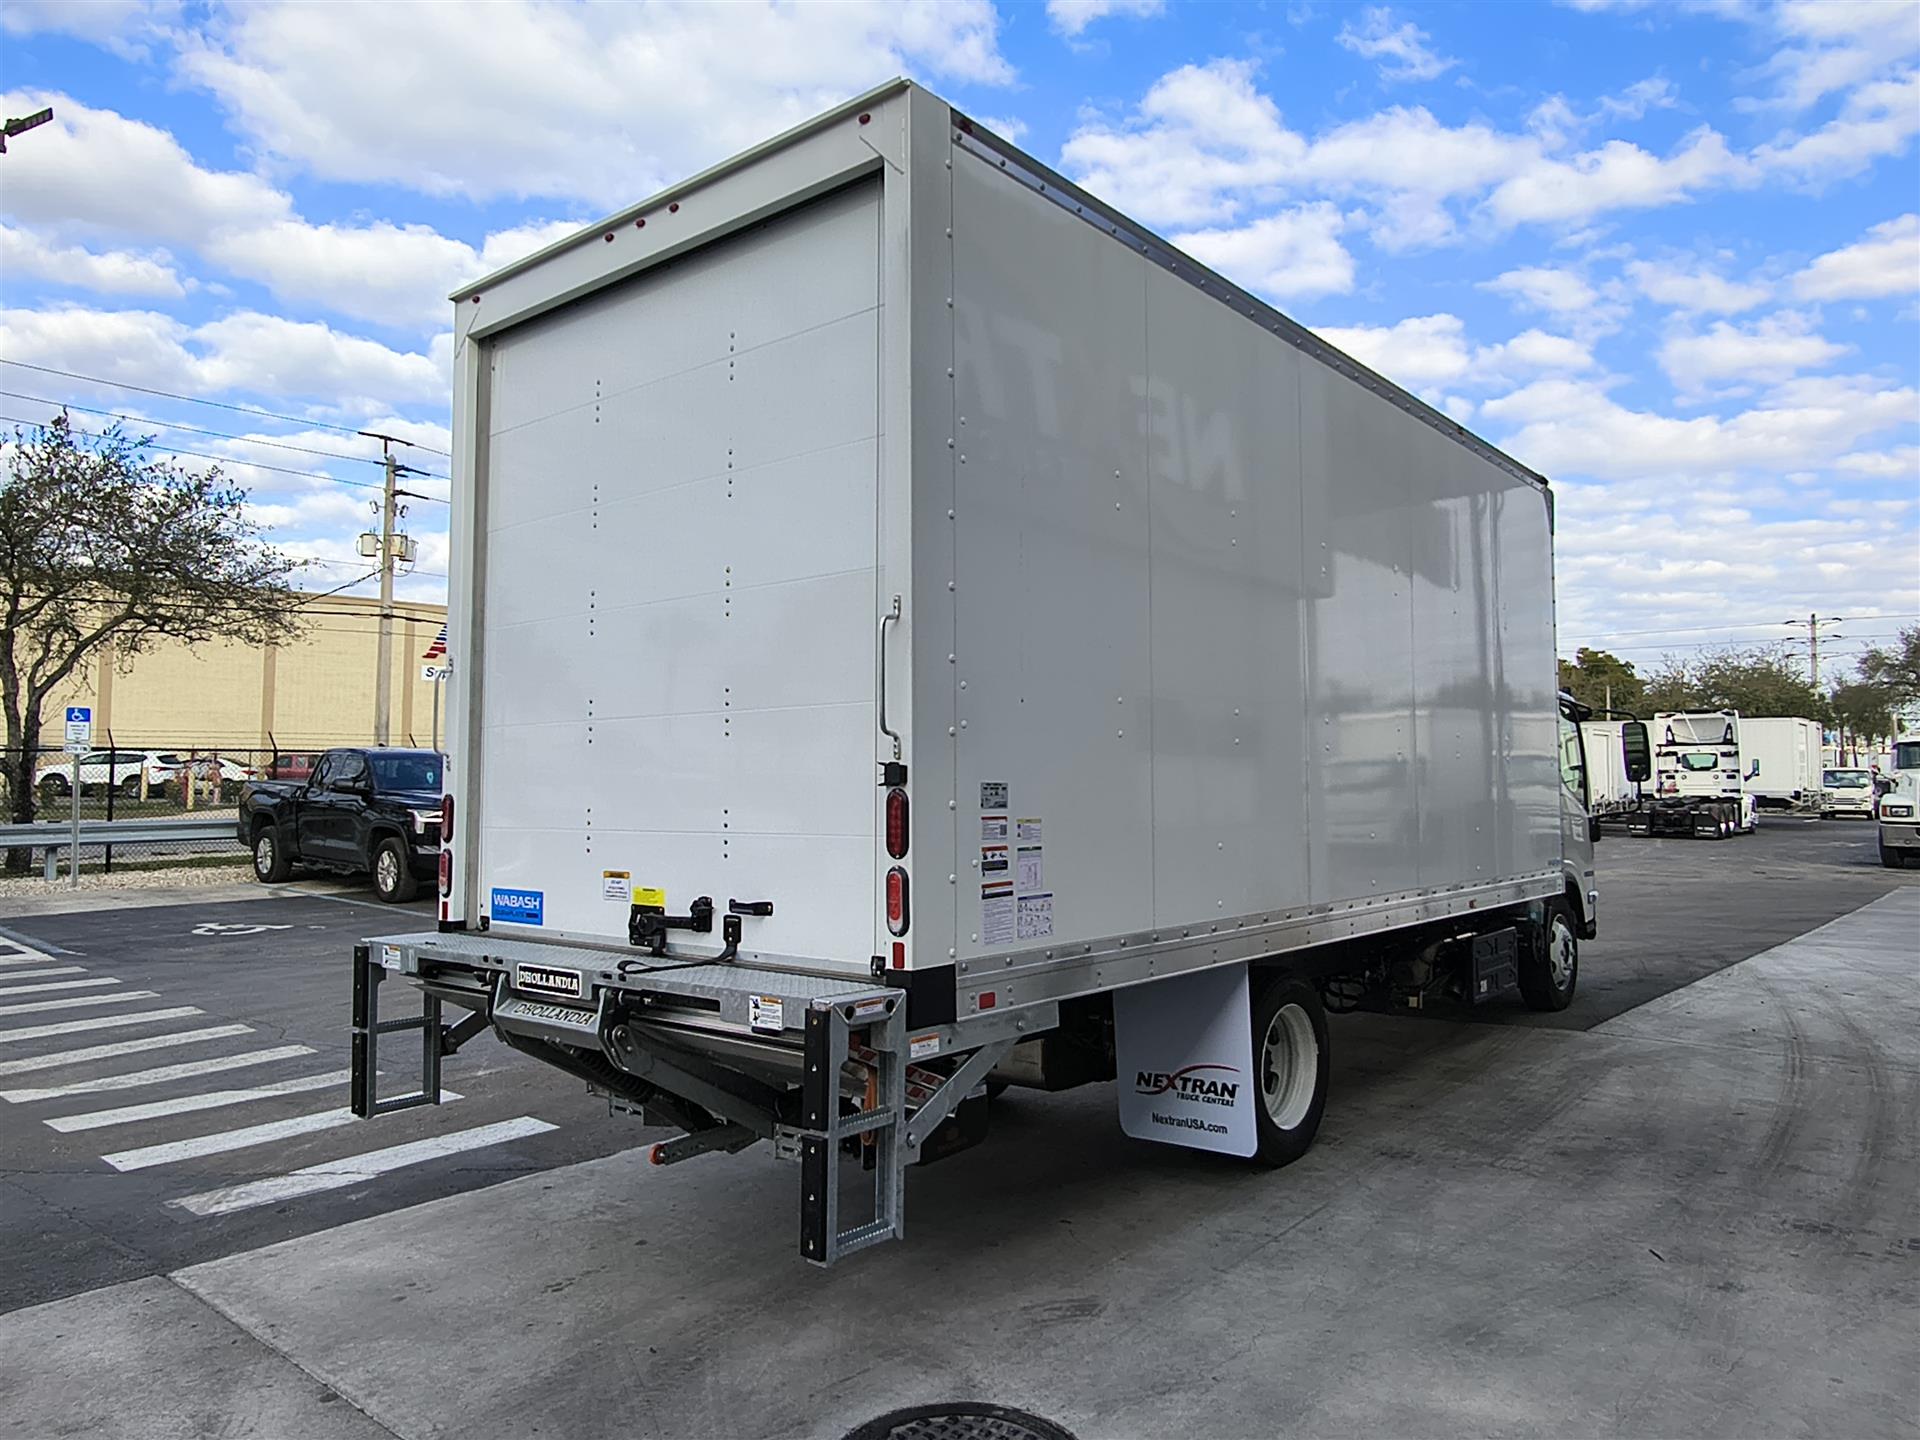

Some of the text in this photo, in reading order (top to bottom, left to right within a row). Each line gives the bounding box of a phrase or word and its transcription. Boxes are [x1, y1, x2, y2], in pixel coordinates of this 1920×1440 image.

[493, 893, 540, 909] WABASH
[519, 970, 579, 990] DHOLLANDIA
[514, 1003, 593, 1025] DHOLLANDIA
[1136, 1070, 1238, 1099] NEXTRAN
[1177, 1092, 1235, 1108] TRUCK CENTERS
[1152, 1112, 1228, 1134] NextranUSA.com
